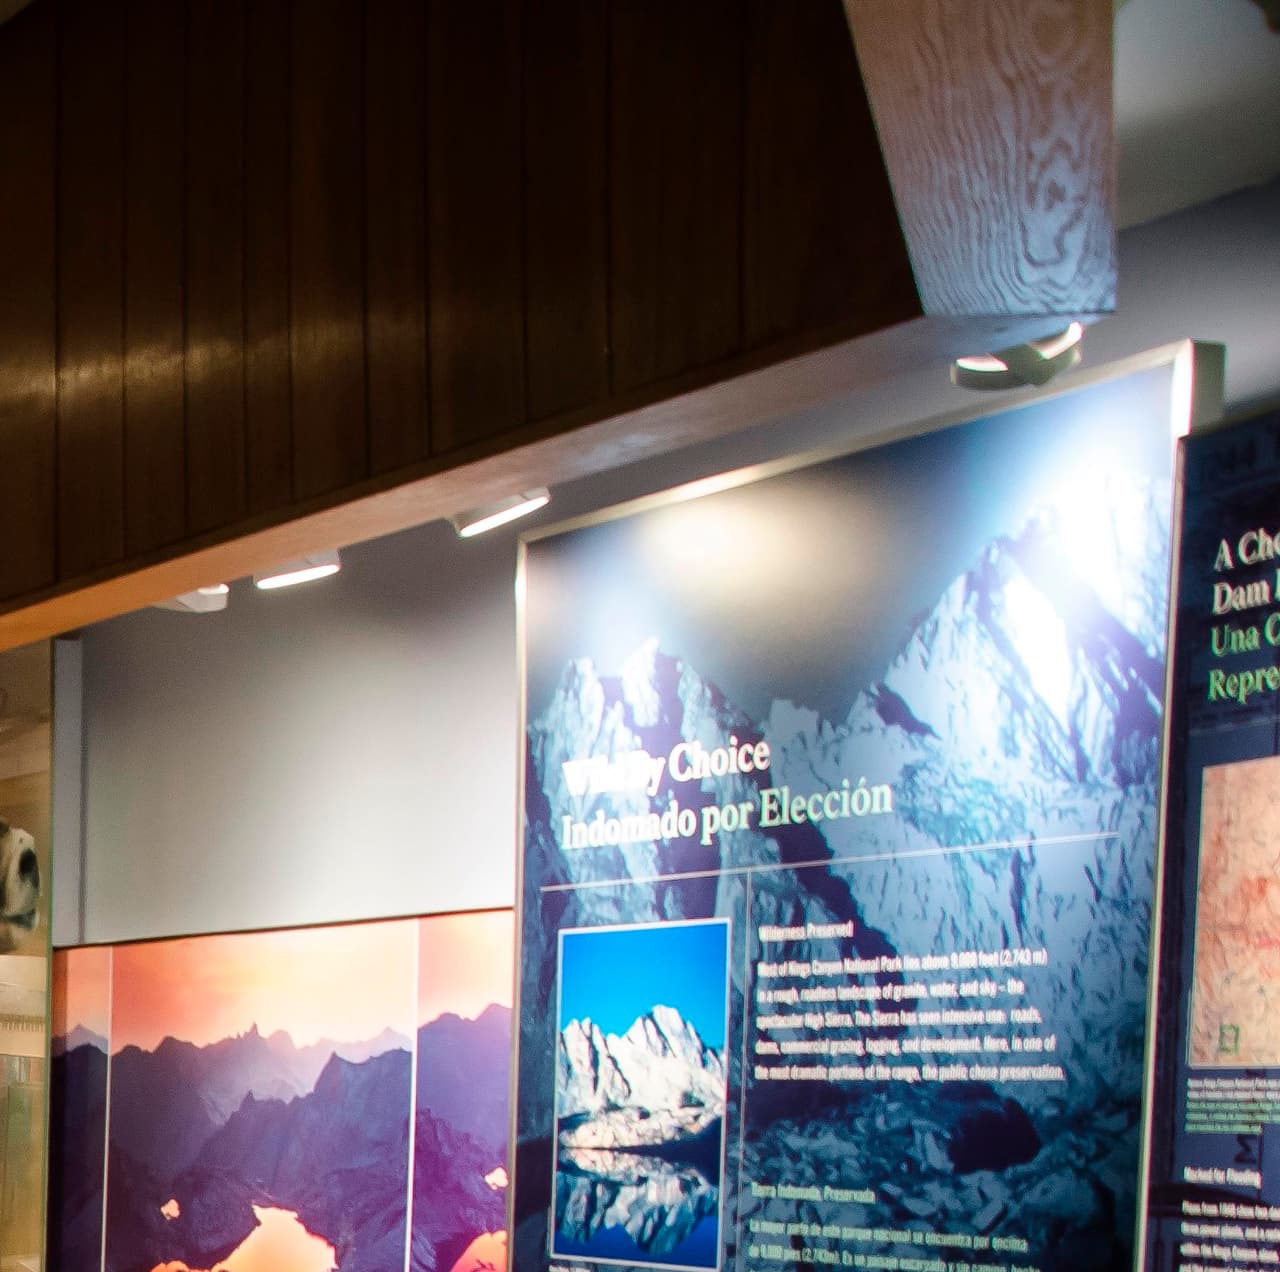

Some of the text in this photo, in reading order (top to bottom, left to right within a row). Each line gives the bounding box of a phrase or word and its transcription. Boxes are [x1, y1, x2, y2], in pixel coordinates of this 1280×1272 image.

[1214, 538, 1233, 571] A
[1213, 579, 1270, 615] Dam
[1212, 625, 1260, 657] Una
[669, 736, 770, 782] Choice
[562, 776, 892, 850] Indomado por Elección
[778, 961, 788, 977] of
[844, 956, 880, 974] National
[881, 955, 902, 973] Park
[979, 952, 999, 968] feet
[882, 982, 893, 999] of
[960, 980, 979, 998] and
[980, 977, 997, 1000] sky
[1007, 978, 1024, 995] the
[805, 1012, 824, 1031] High
[855, 1011, 871, 1026] The
[872, 1010, 900, 1027] Sierra
[900, 1009, 917, 1025] has
[942, 1009, 985, 1025] intensive
[902, 1037, 920, 1053] and
[1012, 1035, 1022, 1052] in
[1023, 1037, 1042, 1052] one
[1044, 1034, 1056, 1052] of
[865, 1064, 875, 1080] of
[876, 1064, 890, 1080] the
[922, 1064, 938, 1081] the
[939, 1064, 968, 1083] public
[969, 1063, 998, 1081] chose
[973, 1236, 989, 1250] por
